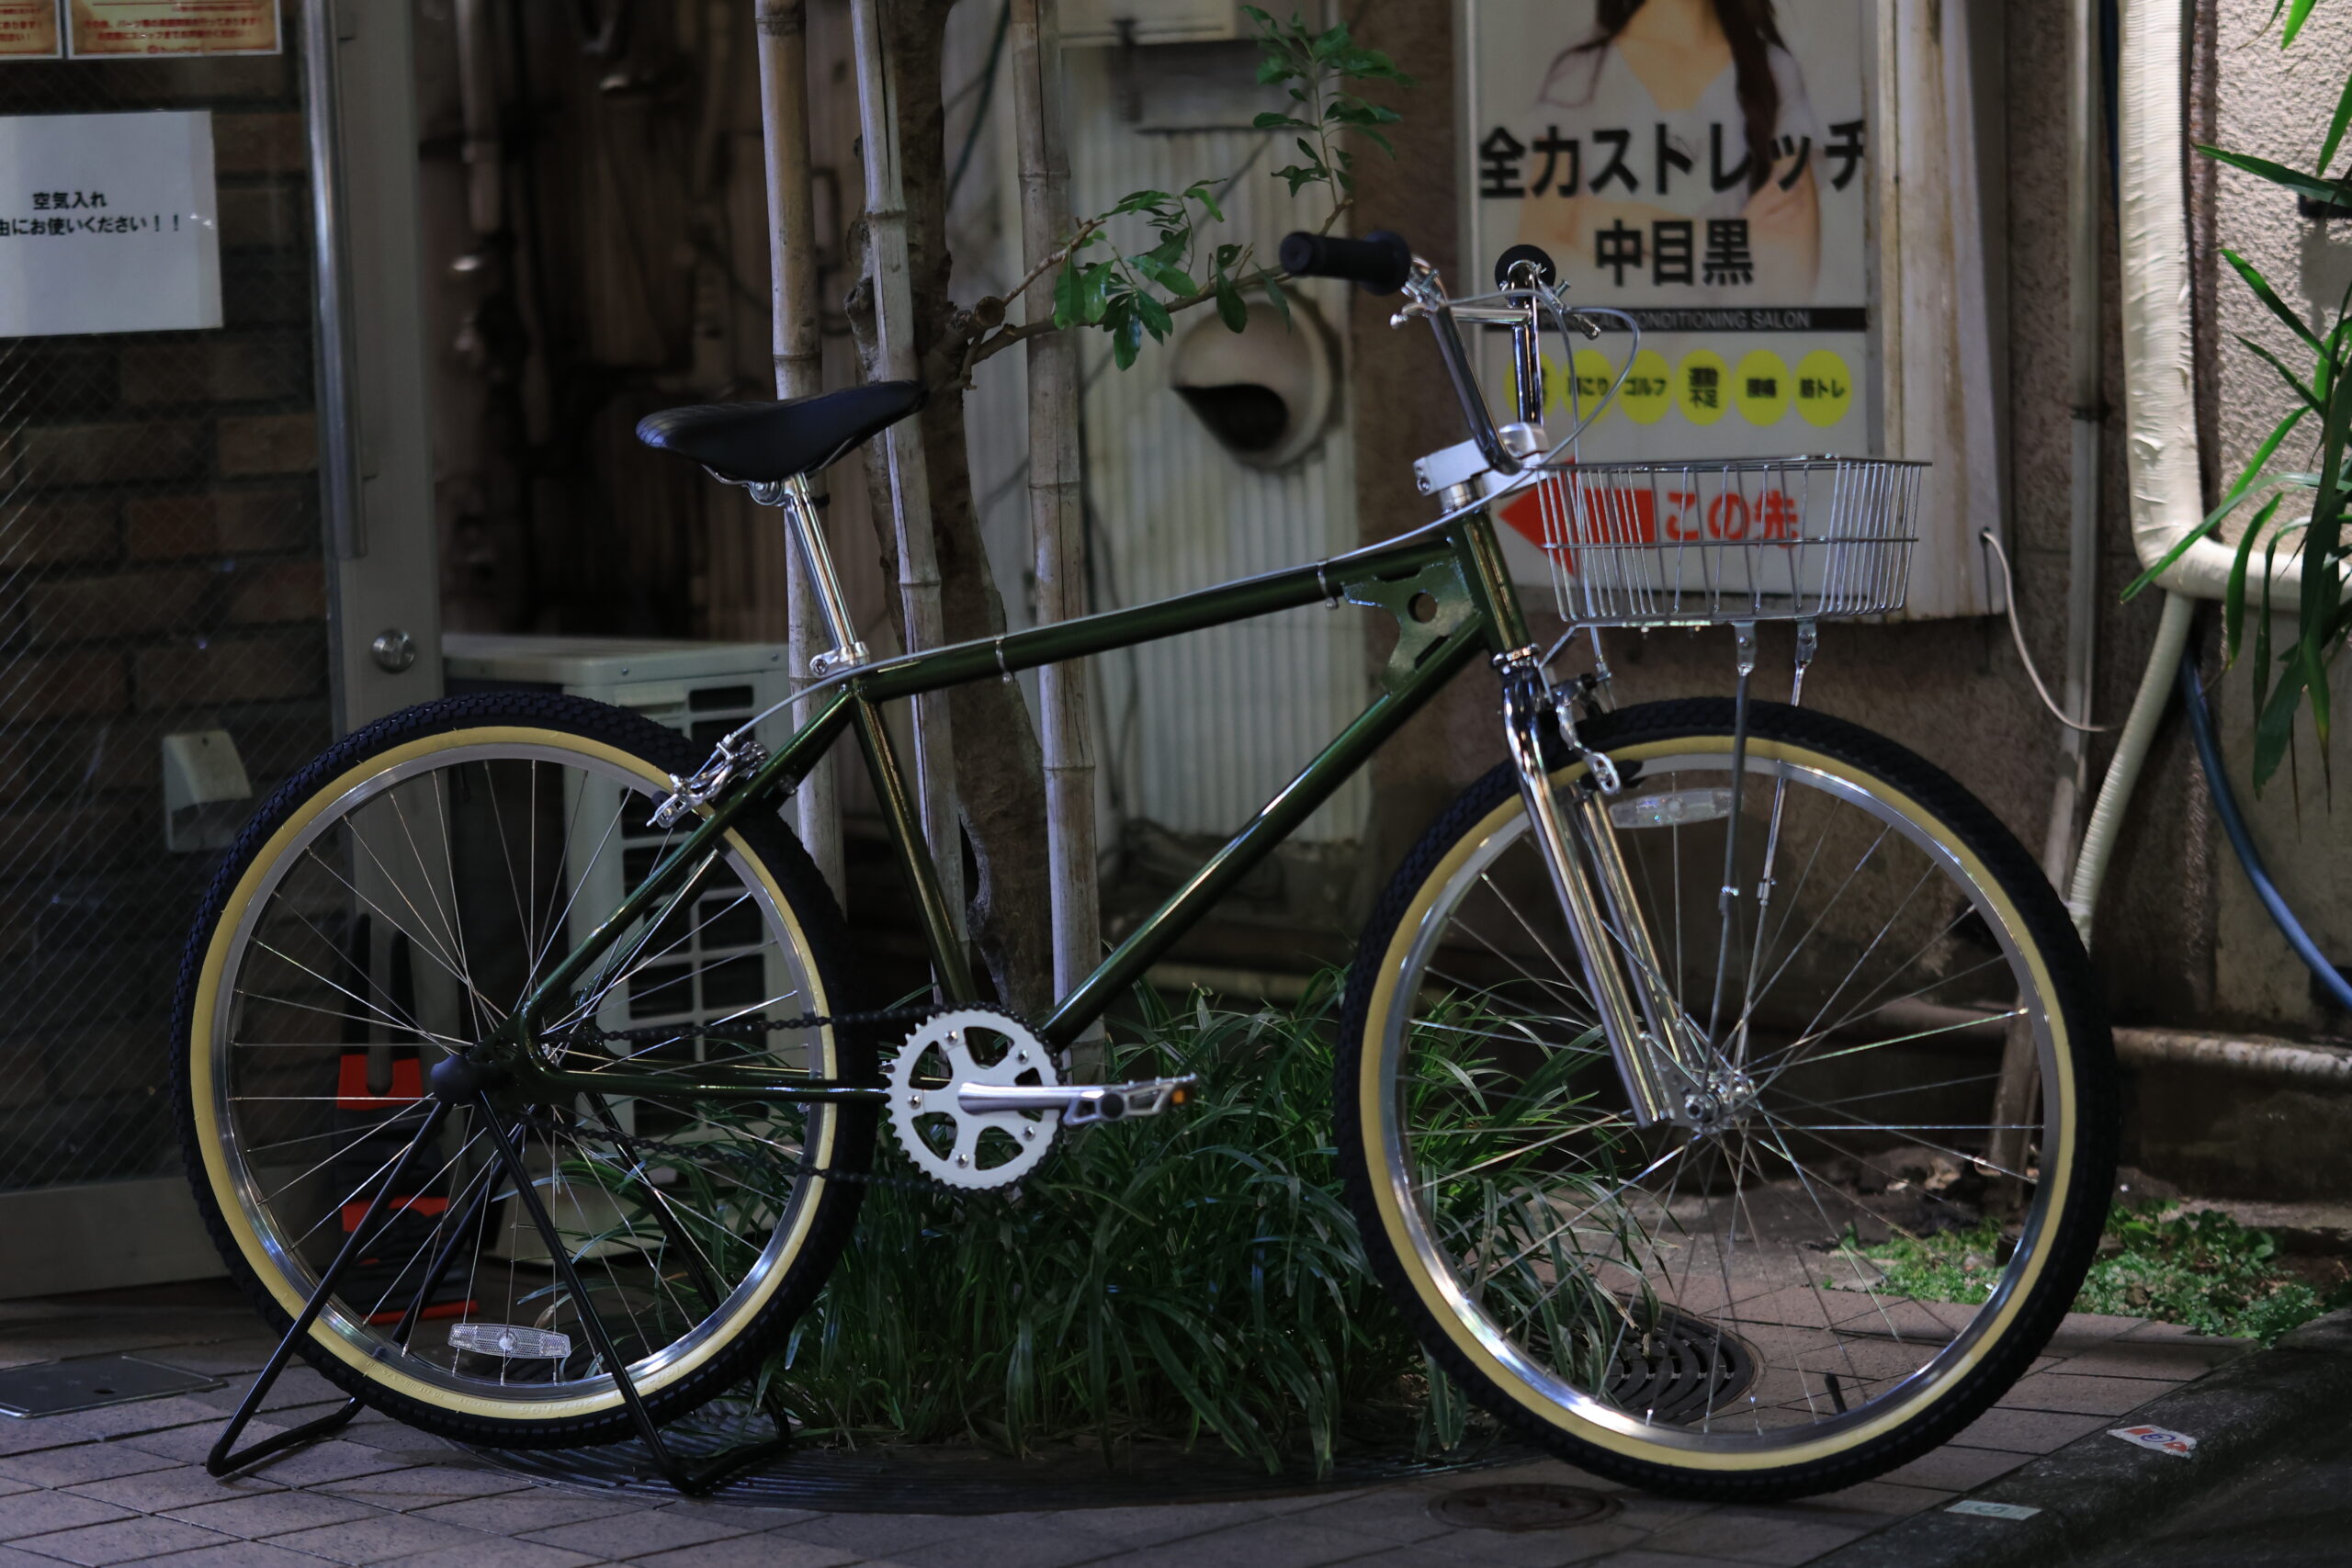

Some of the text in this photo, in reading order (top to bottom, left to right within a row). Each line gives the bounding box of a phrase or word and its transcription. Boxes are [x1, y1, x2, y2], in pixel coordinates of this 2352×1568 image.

[1479, 119, 1864, 198] 全力ストレッチ
[33, 191, 107, 210] 空気入れ
[1596, 219, 1754, 286] 中目黒
[1751, 311, 1810, 329] SALON
[1623, 376, 1668, 397] ゴルフ
[1666, 491, 1798, 549] この先
